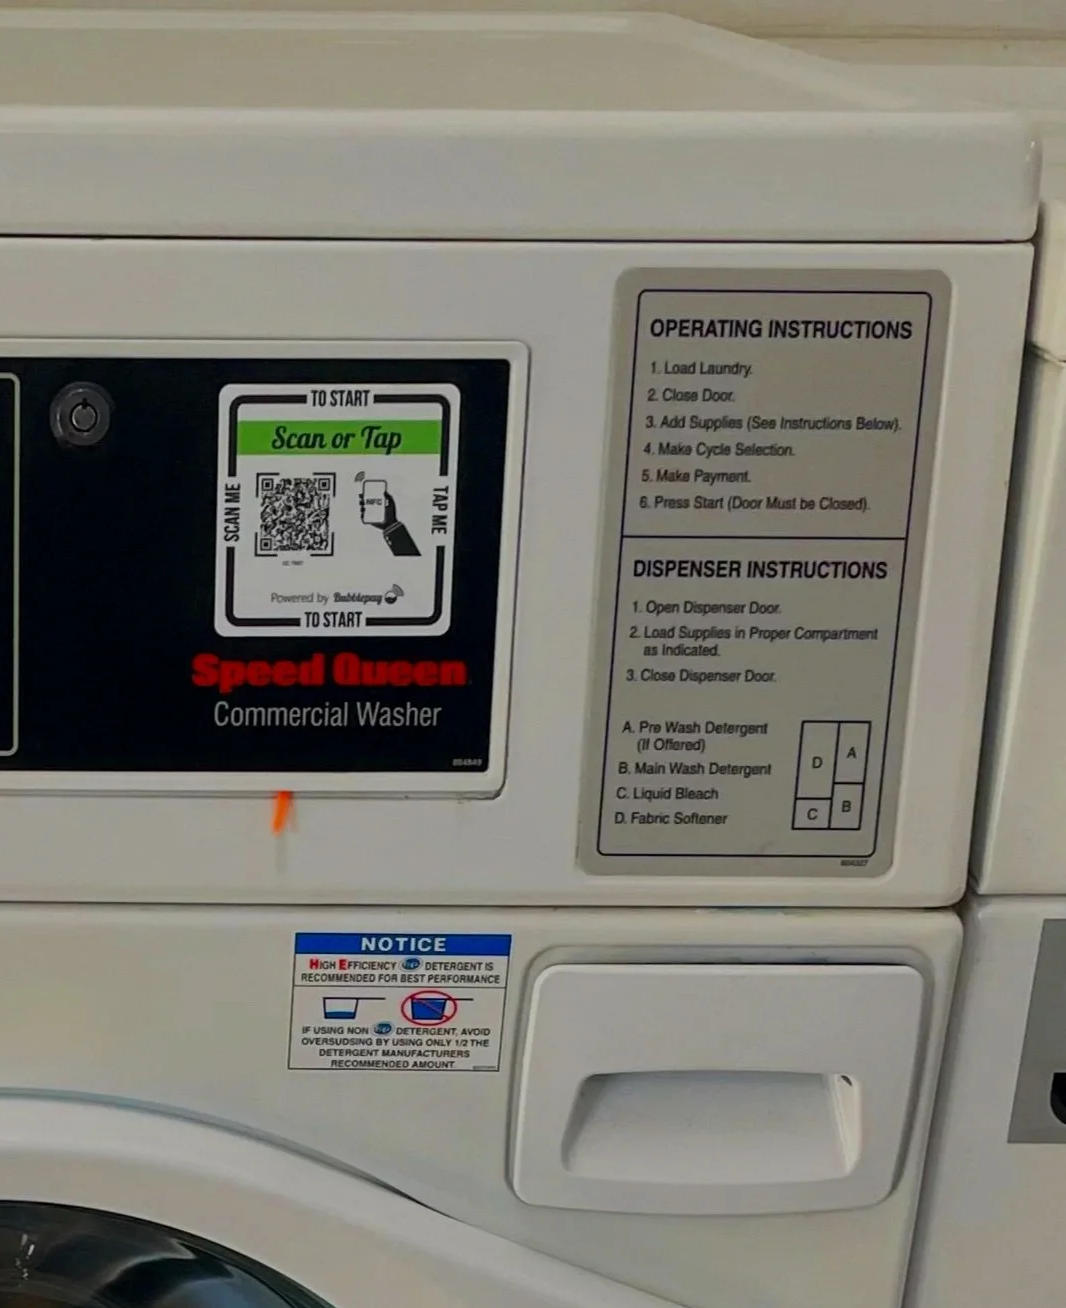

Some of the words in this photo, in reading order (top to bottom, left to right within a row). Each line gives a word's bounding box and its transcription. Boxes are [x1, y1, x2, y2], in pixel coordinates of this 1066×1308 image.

[650, 319, 762, 338] OPERATING
[768, 321, 913, 339] INSTRUCTIONS
[651, 362, 661, 376] 1.
[664, 362, 695, 376] Load
[700, 362, 752, 379] Laundry.
[311, 391, 326, 406] TO
[330, 390, 370, 406] START
[647, 389, 658, 402] 2.
[662, 389, 698, 402] Close
[702, 389, 735, 402] Door.
[646, 416, 656, 429] 3.
[661, 416, 686, 429] Add
[690, 416, 743, 433] Supplies
[747, 417, 776, 432] (See
[780, 418, 852, 431] Instructions
[856, 418, 902, 433] Below).
[272, 426, 326, 448] Scan
[332, 434, 355, 448] or
[361, 426, 402, 455] Tap
[643, 443, 654, 456] 4.
[658, 443, 692, 456] Make
[696, 443, 730, 459] Cycle
[735, 444, 795, 457] Selection.
[642, 470, 653, 482] 5.
[656, 470, 690, 482] Make
[694, 470, 751, 486] Payment.
[225, 483, 240, 500] ME
[433, 486, 449, 512] TAP
[639, 496, 650, 509] 6.
[654, 496, 690, 509] Press
[694, 497, 724, 510] Start
[727, 497, 763, 512] (Door
[766, 497, 796, 510] Must
[800, 498, 815, 510] be
[224, 504, 240, 542] SCAN
[431, 516, 447, 535] ME
[633, 560, 741, 578] DISPENSER
[747, 561, 887, 579] INSTRUCTIONS
[271, 592, 314, 603] Powered
[317, 592, 329, 605] by
[632, 602, 642, 614] 1.
[646, 602, 680, 617] Open
[683, 602, 746, 617] Dispenser
[305, 612, 320, 627] TO
[323, 612, 362, 628] START
[644, 627, 675, 640] Load
[679, 627, 731, 642] Supplies
[735, 627, 746, 640] in
[749, 628, 790, 642] Proper
[794, 628, 878, 643] Compartment
[643, 646, 658, 657] as
[662, 644, 721, 658] Indicated.
[192, 653, 325, 694] Speed
[332, 652, 468, 687] Queen
[626, 669, 637, 682] 3.
[641, 669, 676, 682] Close
[679, 669, 742, 685] Dispenser
[745, 670, 777, 683] Door.
[214, 701, 348, 727] Commercial
[357, 702, 442, 727] Washer
[622, 721, 634, 734] A.
[639, 721, 661, 734] Pre
[665, 722, 701, 735] Wash
[705, 722, 768, 738] Detergent
[637, 738, 650, 753] (If
[653, 738, 705, 753] Offered)
[846, 747, 857, 759] A
[618, 762, 631, 775] B.
[635, 762, 666, 775] Main
[669, 763, 705, 775] Wash
[709, 763, 772, 779] Detergent
[812, 757, 823, 769] D
[616, 787, 629, 800] C.
[633, 787, 672, 802] Liquid
[675, 788, 718, 800] Bleach
[842, 800, 852, 812] B
[615, 812, 628, 825] D.
[631, 812, 670, 825] Fabric
[673, 812, 728, 825] Softener
[807, 808, 818, 821] C
[361, 937, 447, 952] NOTICE
[425, 962, 482, 971] DETERGENT
[485, 962, 494, 971] IS
[301, 974, 375, 983] RECOMMENDED
[378, 975, 398, 983] FOR
[401, 975, 426, 983] BEST
[428, 975, 500, 984] PERFORMANCE
[314, 1027, 344, 1035] USING
[347, 1027, 368, 1035] NON
[396, 1027, 458, 1036] DETERGENT,
[461, 1028, 490, 1036] AVOID
[302, 1038, 372, 1046] OVERSUDSING
[375, 1038, 390, 1046] BY
[392, 1038, 424, 1046] USING
[455, 1039, 468, 1047] 1/2
[470, 1039, 489, 1047] THE
[319, 1049, 378, 1057] DETERGENT
[382, 1049, 470, 1058] MANUFACTURERS
[331, 1060, 409, 1068] RECOMMENDED
